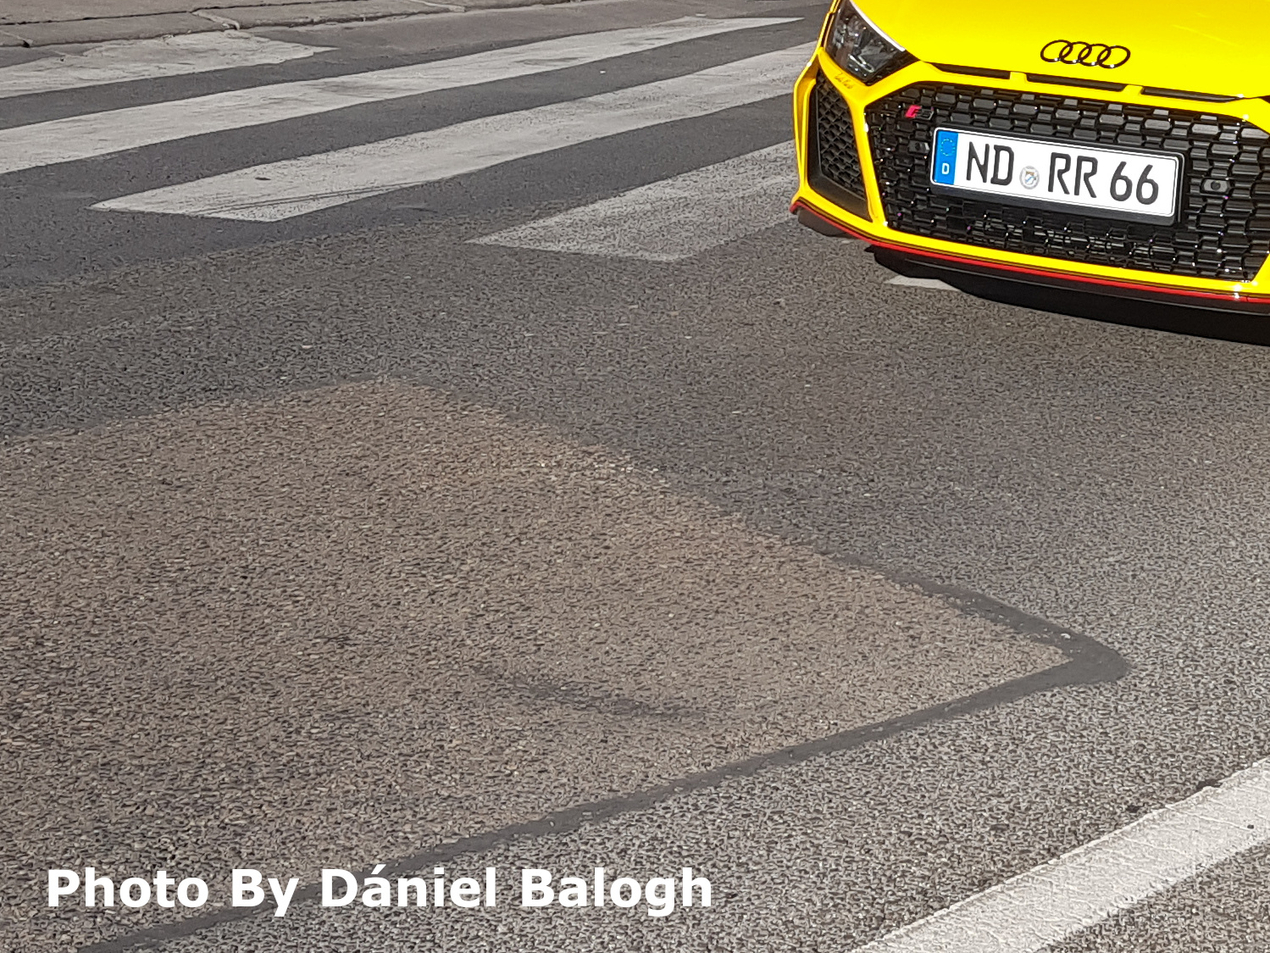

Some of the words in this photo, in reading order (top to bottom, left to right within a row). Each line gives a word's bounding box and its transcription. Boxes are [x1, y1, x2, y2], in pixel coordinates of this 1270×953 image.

[941, 162, 950, 175] D
[966, 141, 1015, 186] ND
[1047, 152, 1098, 198] RR
[1109, 161, 1159, 205] 66
